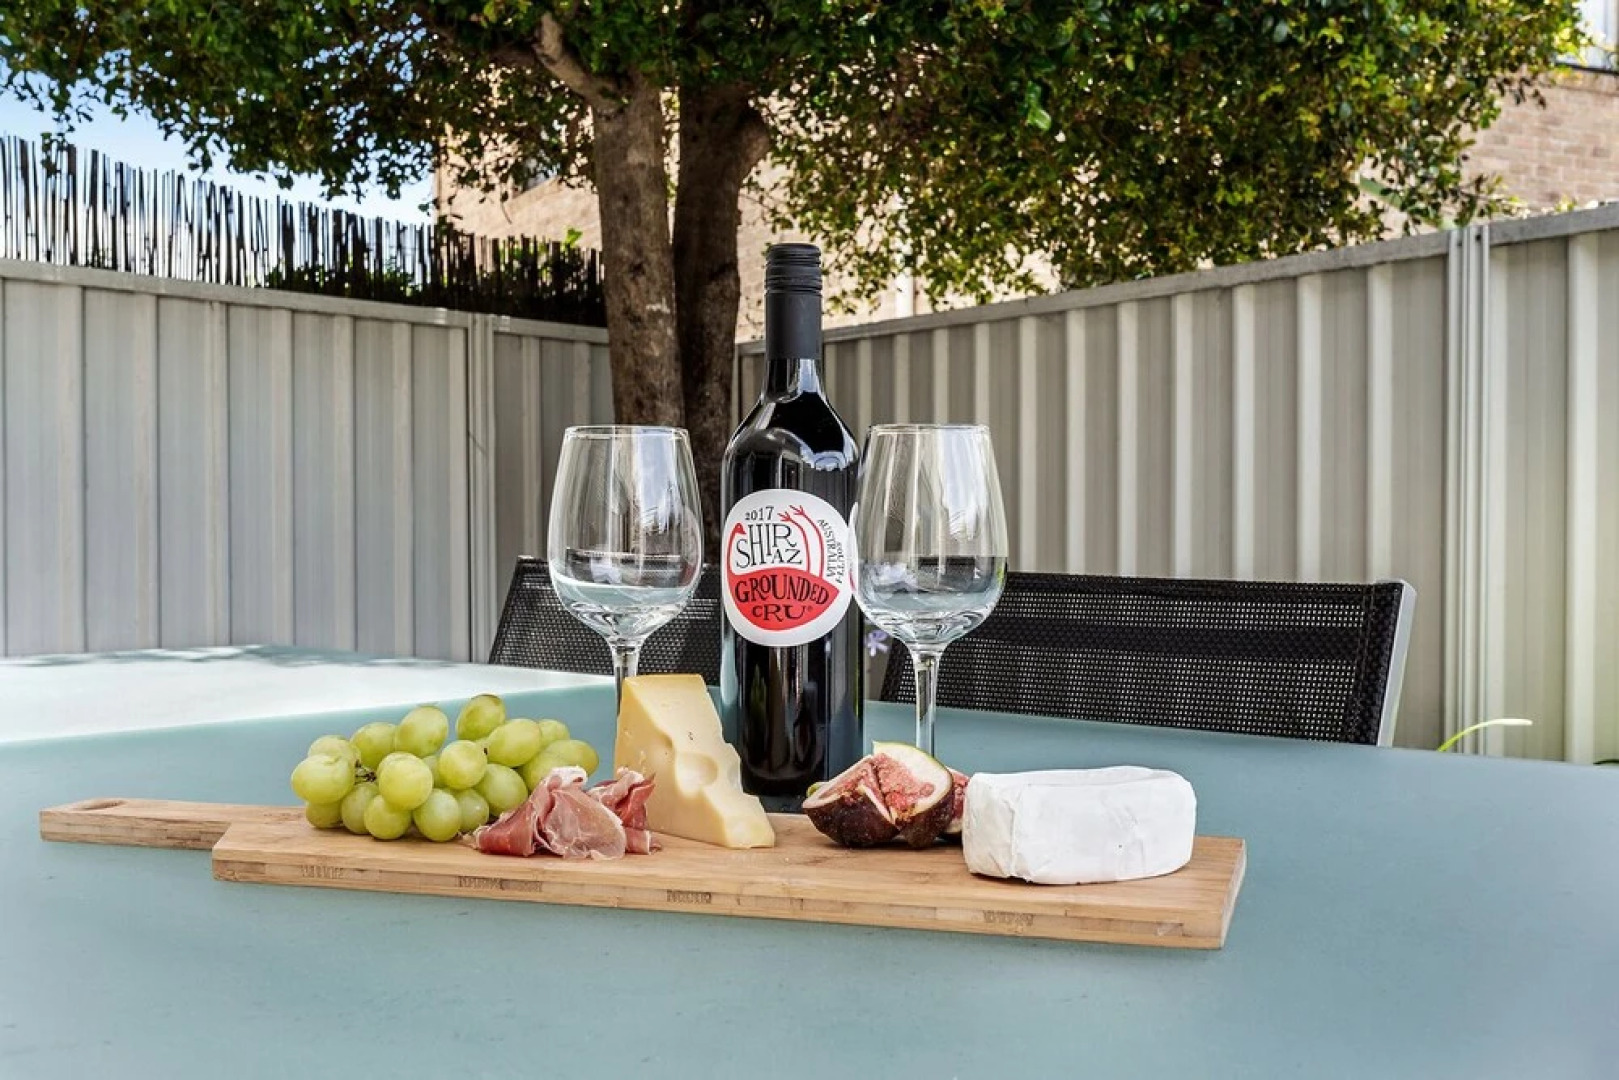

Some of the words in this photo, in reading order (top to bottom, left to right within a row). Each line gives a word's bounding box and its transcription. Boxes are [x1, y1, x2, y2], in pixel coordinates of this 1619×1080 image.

[745, 505, 774, 521] 2017
[817, 519, 837, 578] AUSTRALIA
[735, 574, 830, 605] GROUNDED
[752, 603, 806, 622] CRU
